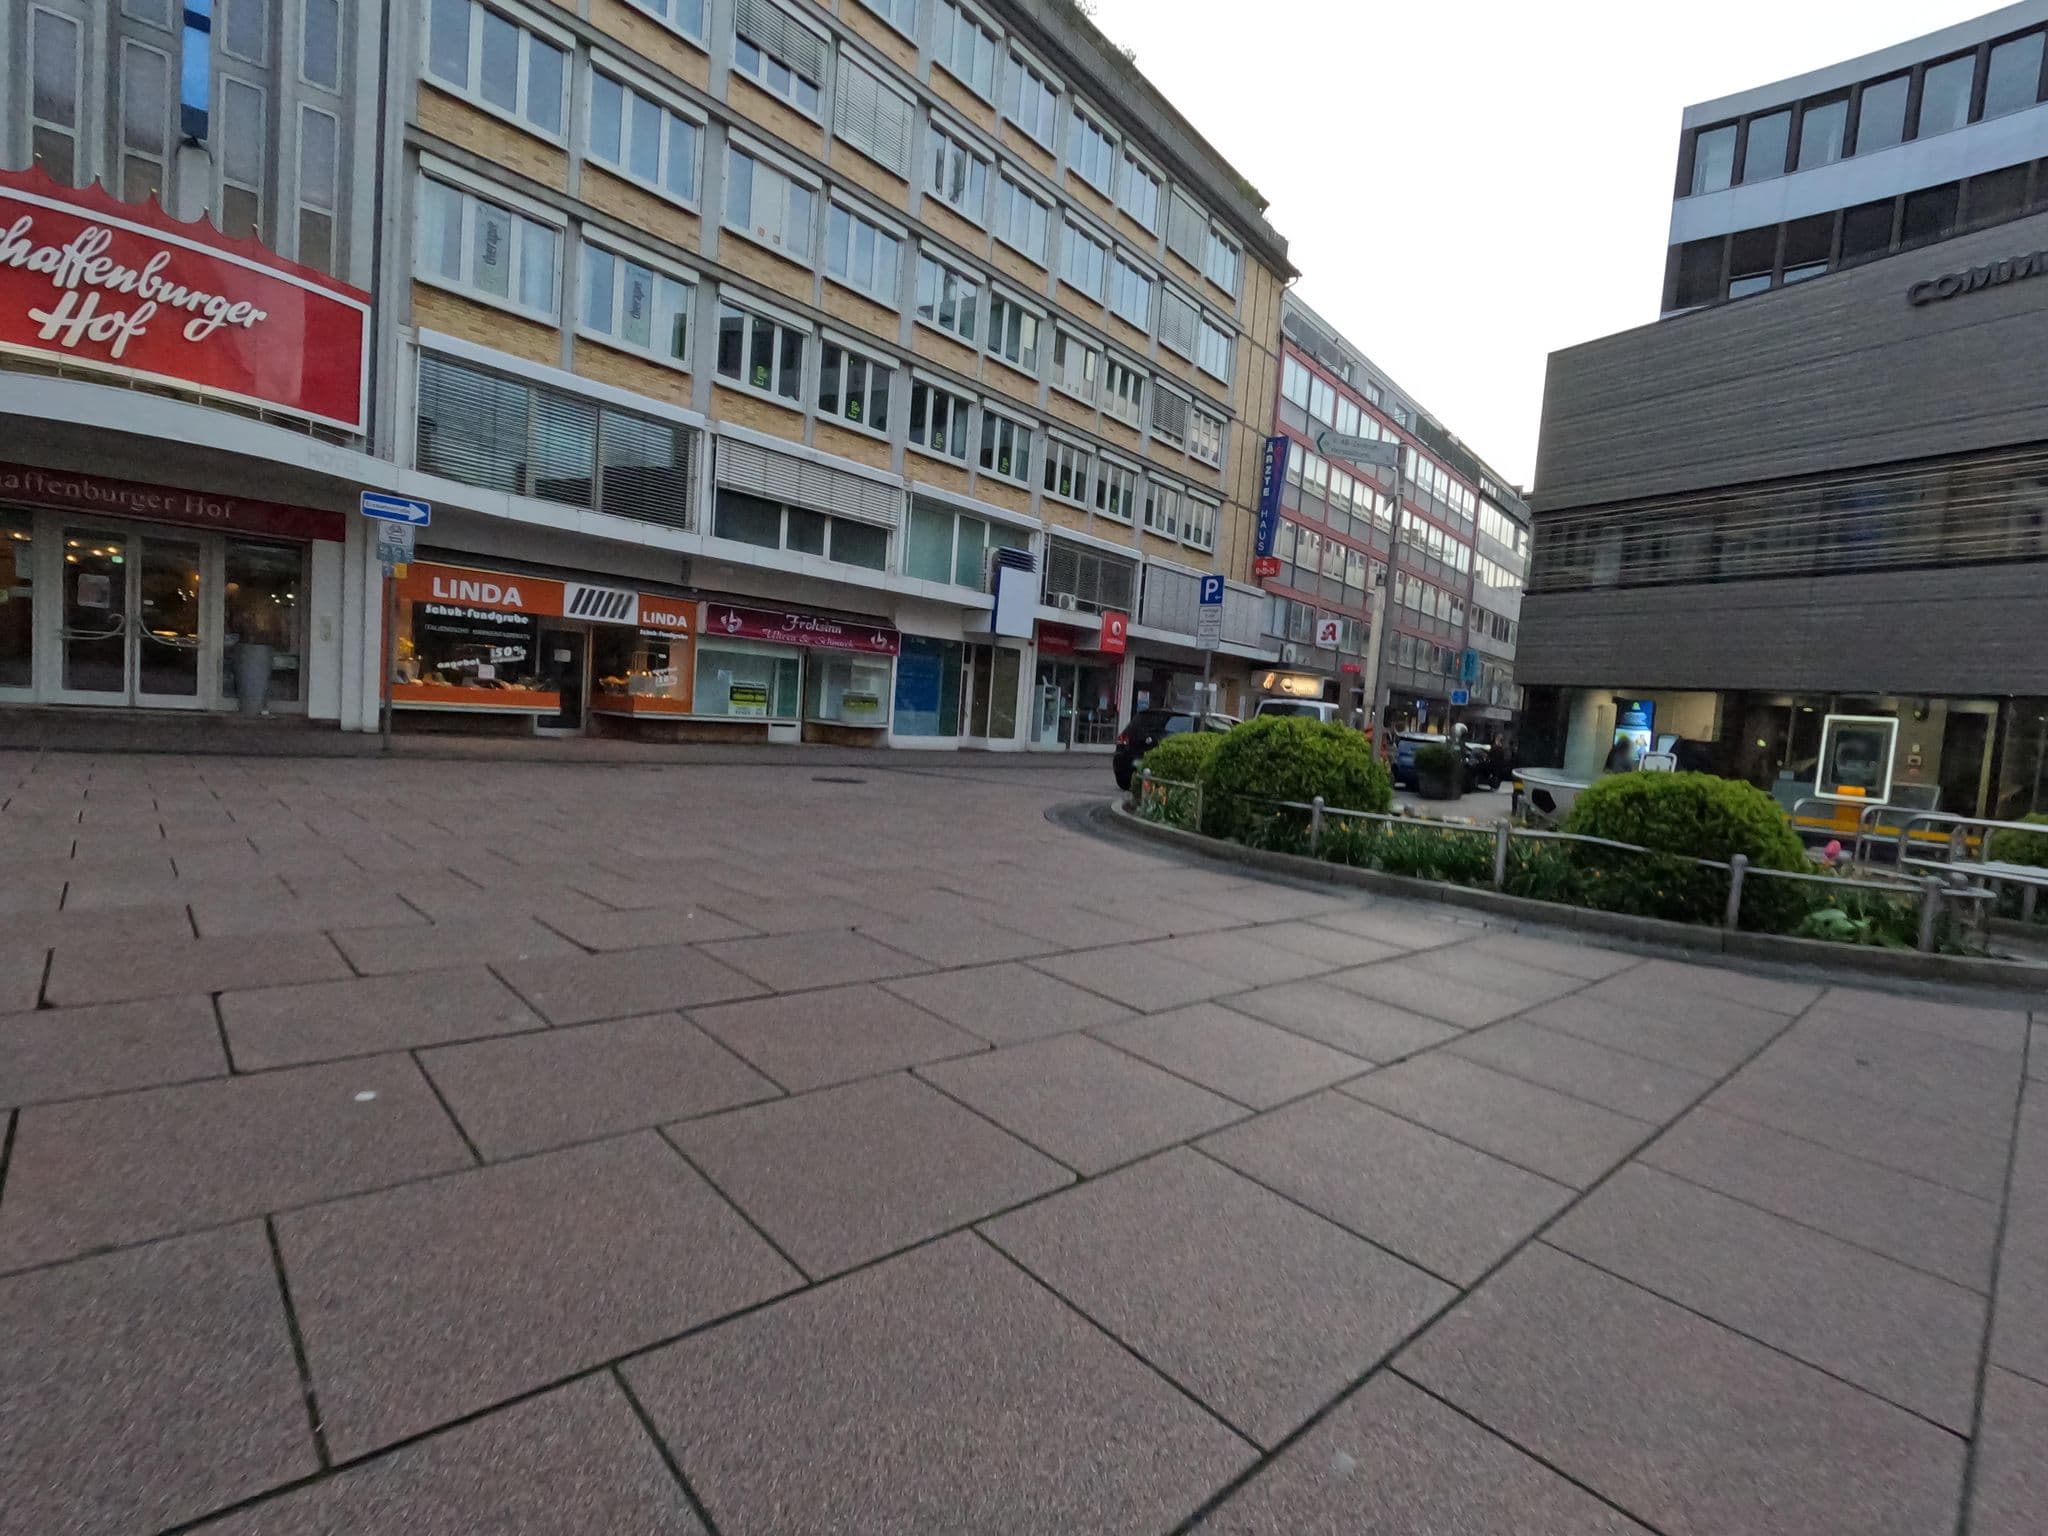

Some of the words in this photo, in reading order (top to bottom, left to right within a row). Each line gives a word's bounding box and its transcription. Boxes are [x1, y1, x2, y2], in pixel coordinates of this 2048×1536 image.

[28, 290, 157, 359] Hof
[847, 400, 861, 419] Ergo
[1262, 441, 1274, 496] ÄRZTE
[184, 494, 237, 519] Hof
[1258, 509, 1268, 551] HAUS
[432, 576, 523, 607] LINDA
[1204, 578, 1219, 602] P
[642, 611, 688, 628] LINDA
[781, 613, 842, 634] Frohsinn
[799, 633, 810, 643] &
